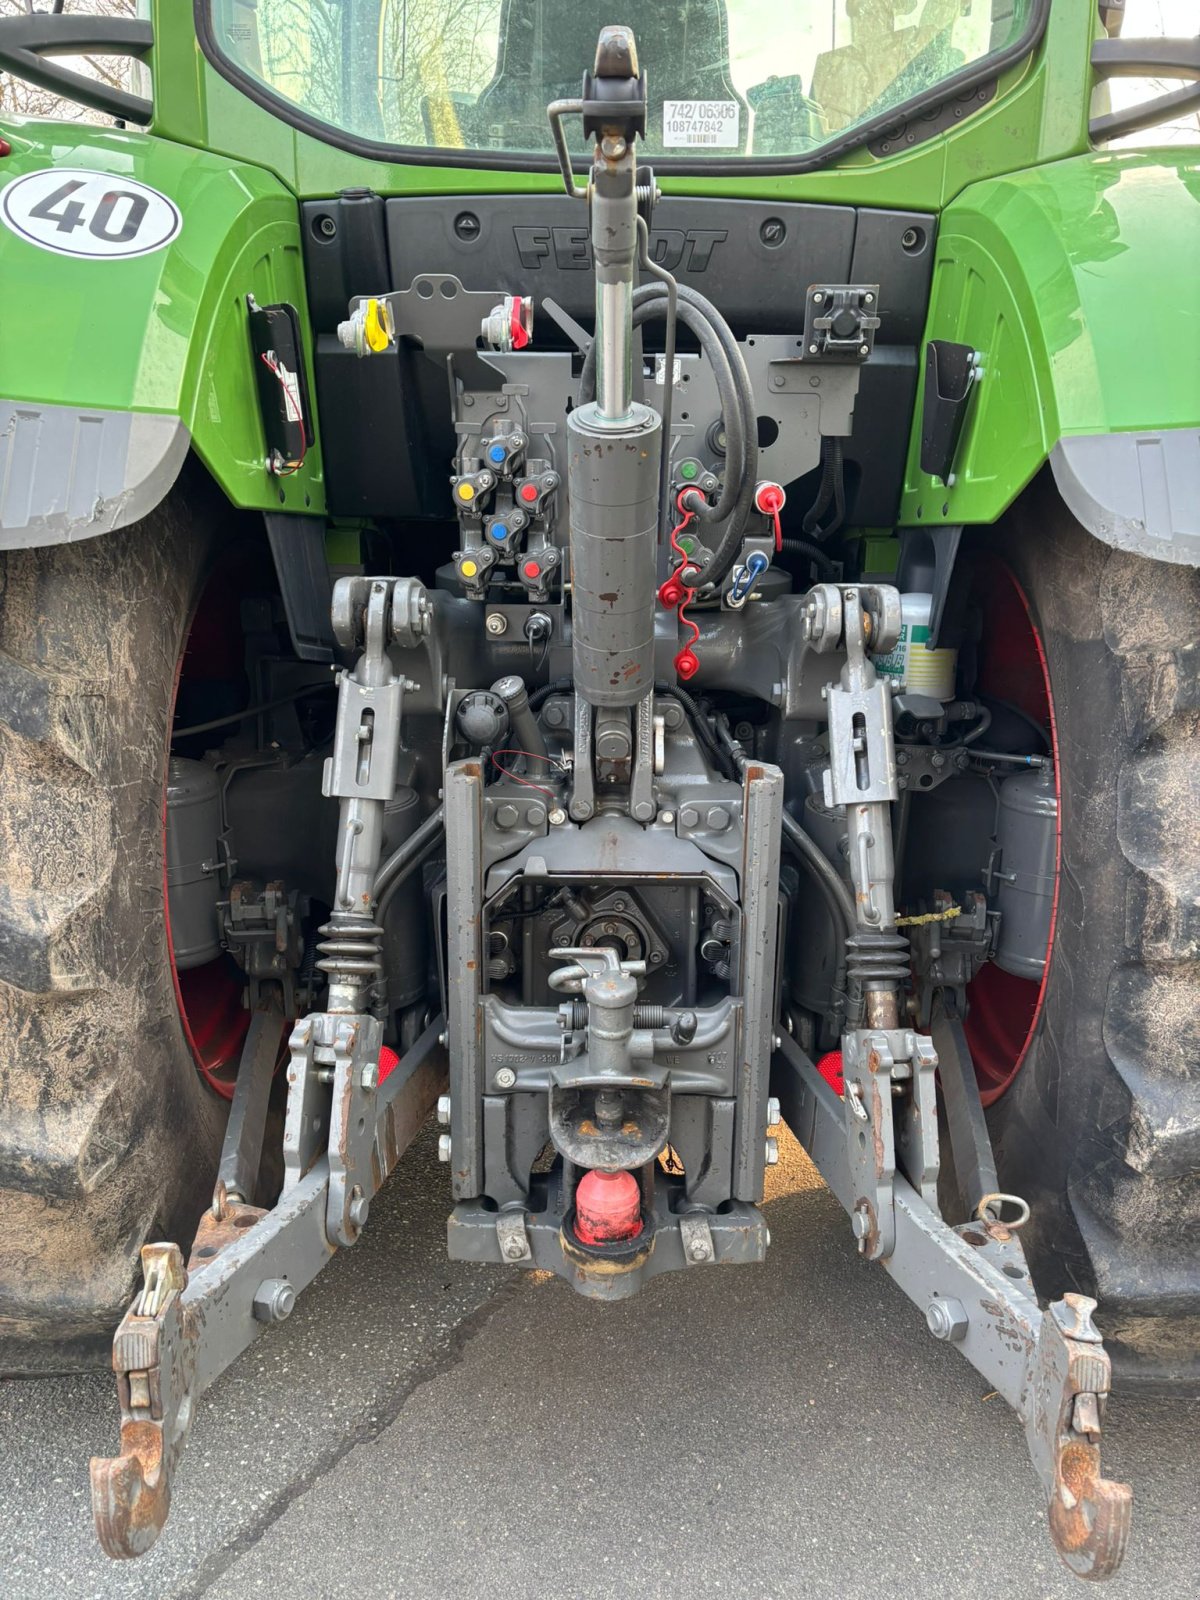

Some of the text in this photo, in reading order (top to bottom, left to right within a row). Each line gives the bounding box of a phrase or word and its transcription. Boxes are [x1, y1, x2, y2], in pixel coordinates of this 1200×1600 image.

[666, 120, 723, 133] 108747842
[28, 179, 150, 243] 40
[512, 225, 729, 272] FEDT
